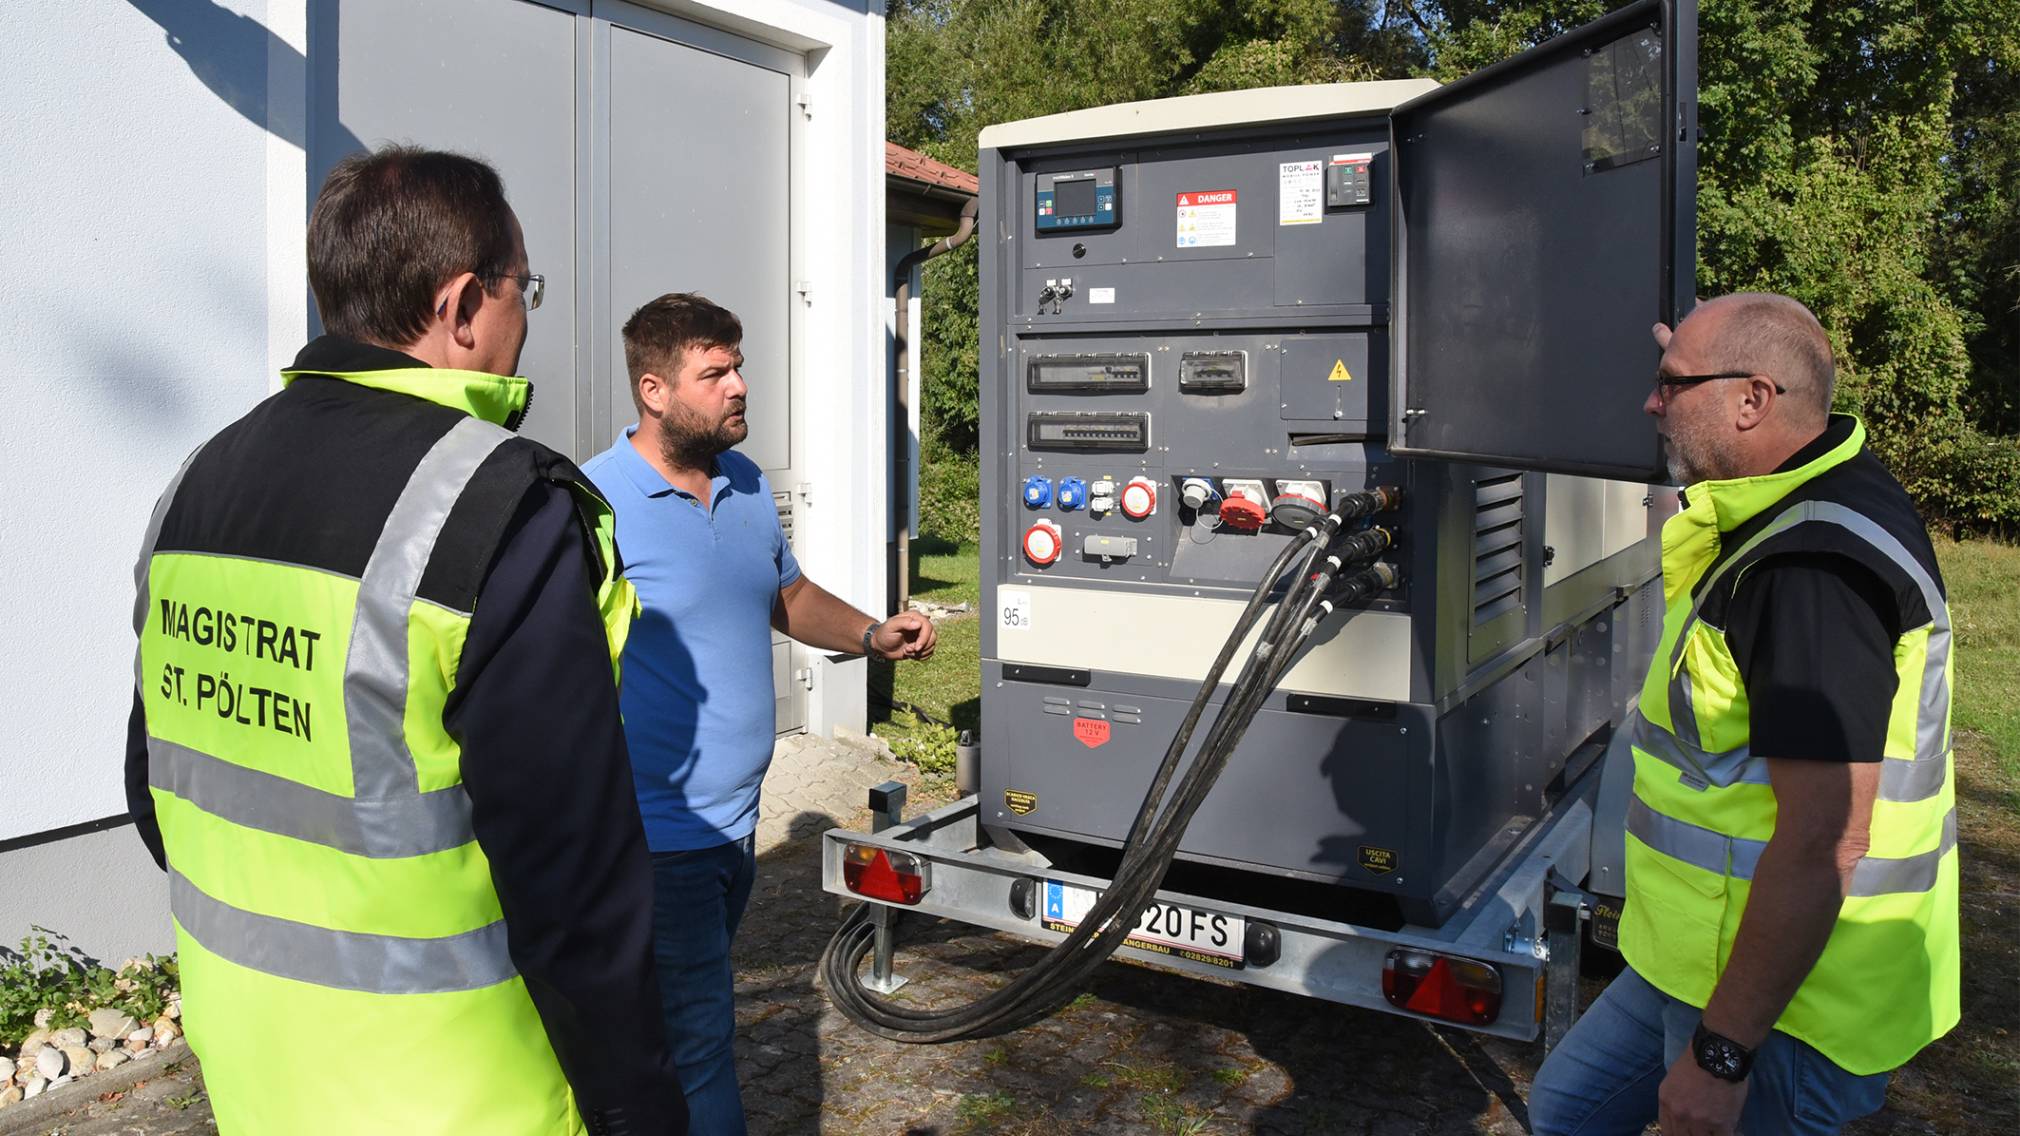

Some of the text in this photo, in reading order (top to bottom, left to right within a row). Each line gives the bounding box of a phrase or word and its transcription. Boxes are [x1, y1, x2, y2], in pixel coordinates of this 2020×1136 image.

[1198, 193, 1232, 204] DANGER
[1003, 606, 1020, 626] 95
[160, 598, 321, 671] MAGISTRAT
[160, 663, 312, 742] ST. PÖLTEN
[1076, 721, 1107, 730] BATTERY
[1085, 728, 1093, 736] 12
[1365, 848, 1391, 858] USCITA
[1051, 902, 1060, 913] A
[1133, 902, 1228, 947] 20 FS
